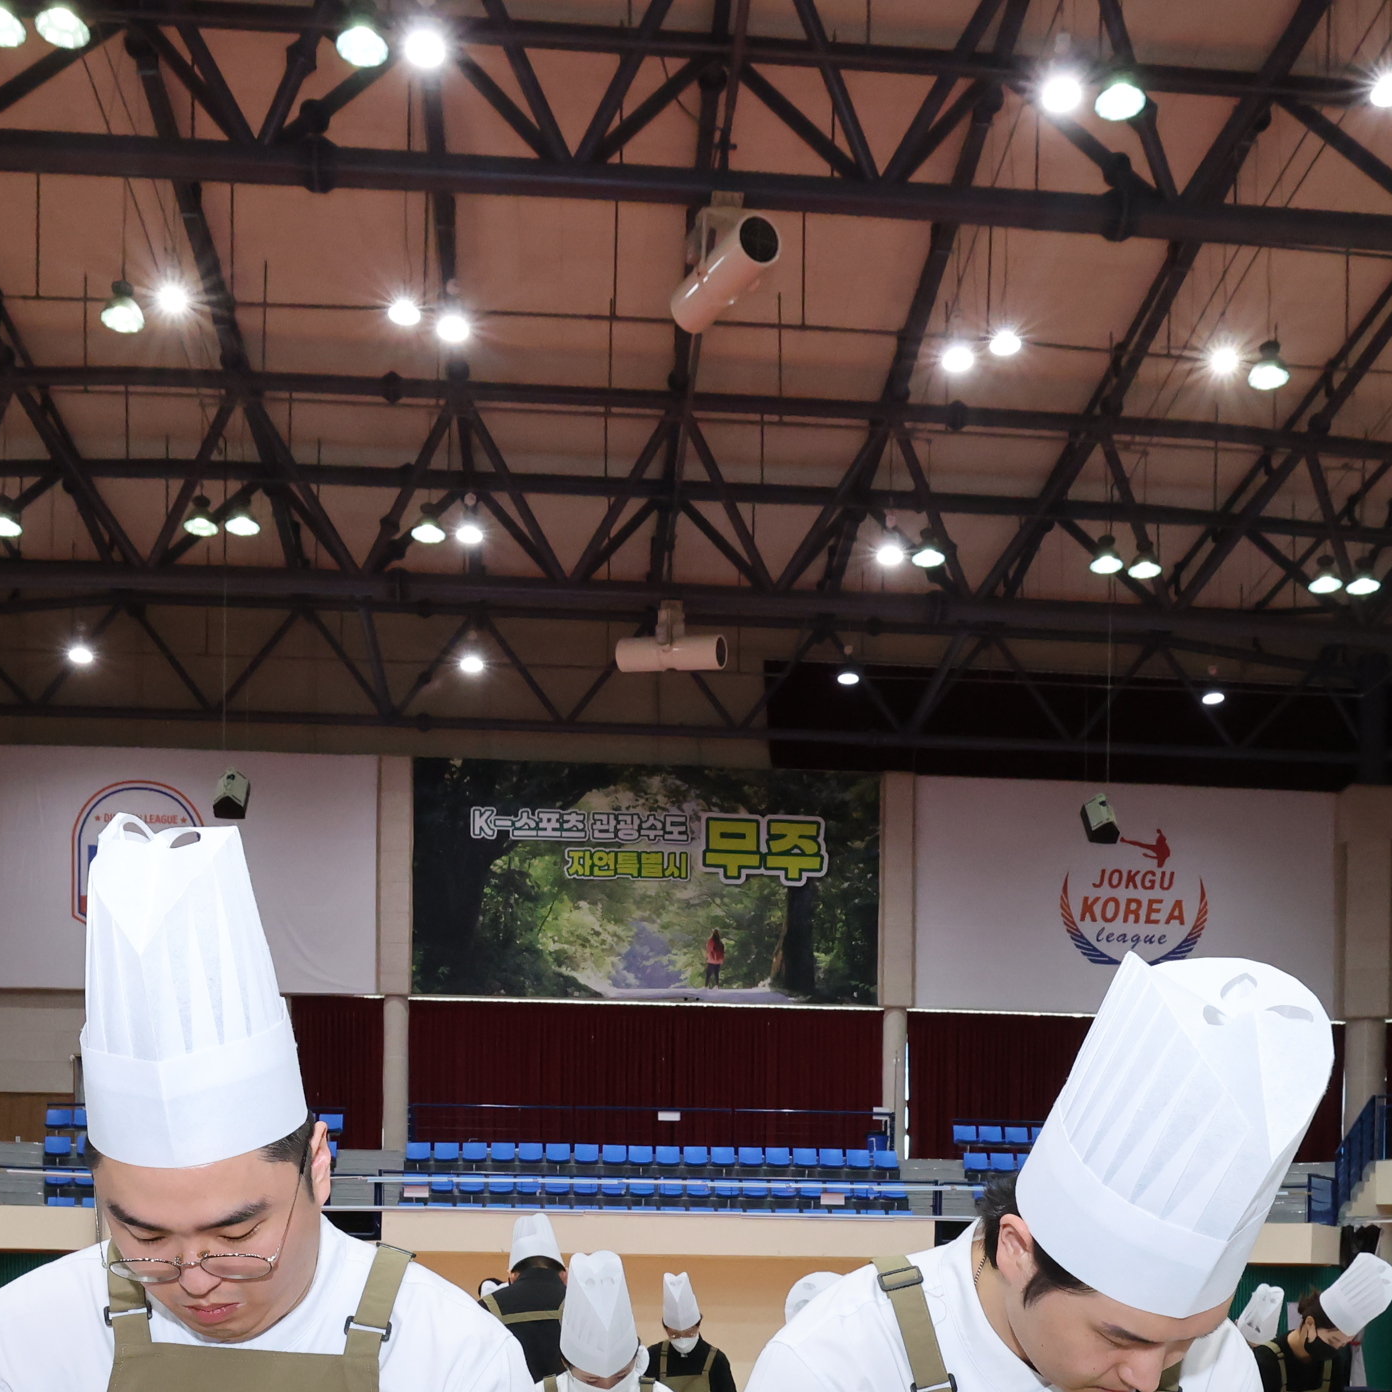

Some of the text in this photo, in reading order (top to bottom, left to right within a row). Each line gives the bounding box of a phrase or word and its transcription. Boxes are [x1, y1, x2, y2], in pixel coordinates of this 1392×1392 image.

[145, 815, 178, 825] LEAGUE
[471, 807, 826, 884] K-스포츠 관광수도 무주
[565, 848, 691, 881] 자연특별시
[1092, 868, 1175, 891] JOKGU
[1080, 896, 1185, 926] KOREA
[1096, 927, 1167, 950] league
